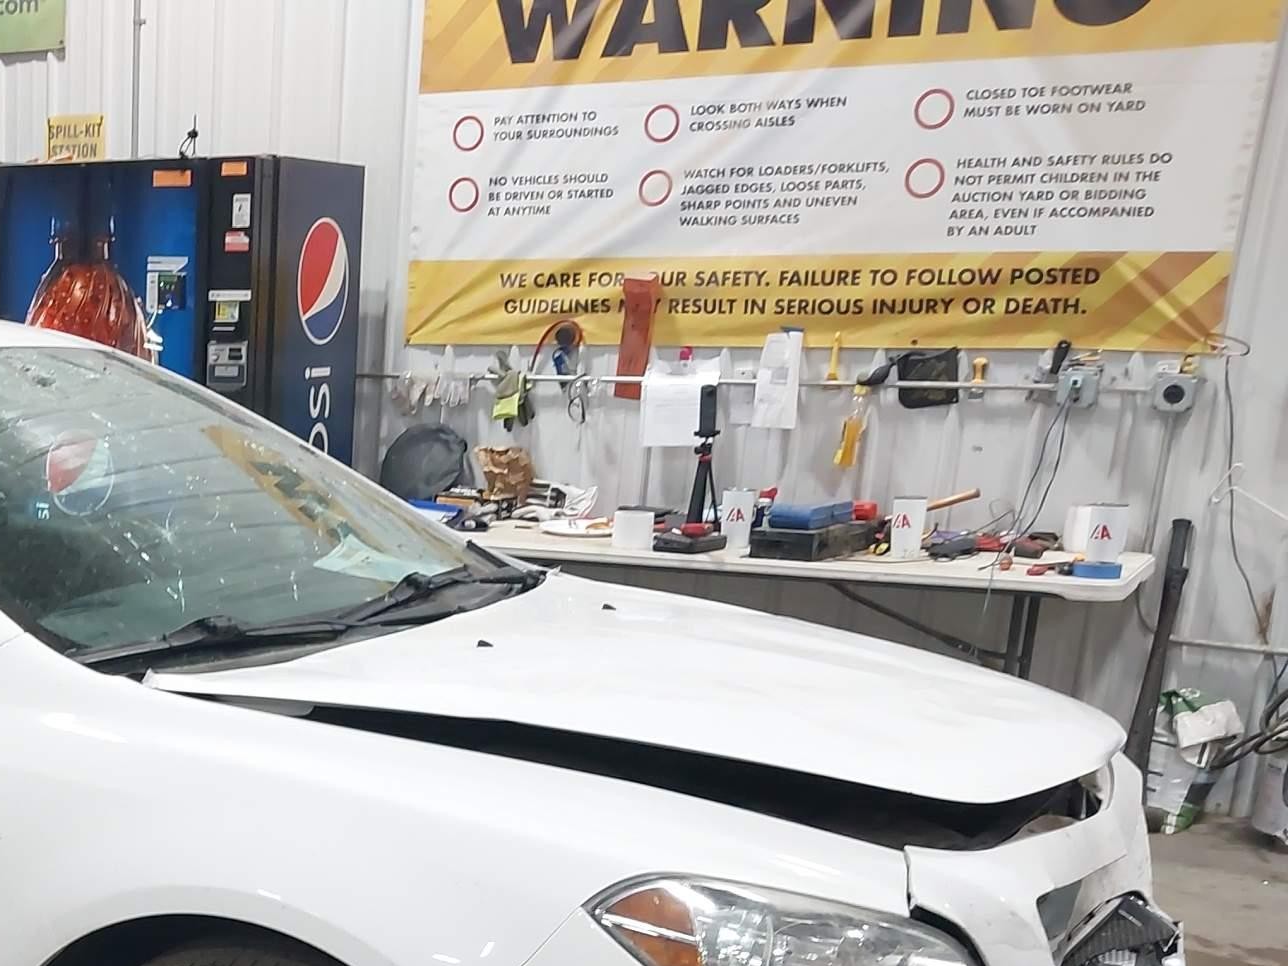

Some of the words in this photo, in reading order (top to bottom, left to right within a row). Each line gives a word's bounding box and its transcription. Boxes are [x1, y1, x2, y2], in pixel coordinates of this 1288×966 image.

[496, 0, 1152, 63] WARN
[966, 88, 1017, 101] CLOSED
[1021, 86, 1046, 98] TOE
[1050, 83, 1133, 97] FOOTWEAR
[690, 103, 725, 116] LOOK
[729, 101, 763, 114] BOTH
[765, 98, 802, 111] WAYS
[806, 96, 848, 109] WHEN
[963, 106, 1002, 118] MUST
[1005, 104, 1021, 116] BE
[1025, 103, 1072, 116] WORN
[1077, 102, 1101, 114] ON
[1106, 100, 1146, 112] YARD
[494, 116, 513, 126] PAY
[516, 113, 578, 125] ATTENTION
[582, 111, 597, 122] TO
[689, 118, 751, 132] CROSSING
[755, 115, 796, 127] AISLES
[49, 123, 101, 140] SPILL-KIT
[493, 131, 522, 142] YOUR
[527, 126, 619, 140] SURROUNDINGS
[957, 157, 1007, 169] HEALTH
[1011, 156, 1042, 167] AND
[1047, 154, 1097, 166] SAFETY
[1101, 153, 1145, 165] RULES
[1149, 152, 1173, 164] DO
[684, 167, 725, 180] WATCH
[729, 166, 754, 178] FOR
[759, 161, 890, 177] LOADERS/FORKLIFTS,
[954, 175, 983, 186] NOT
[987, 173, 1036, 185] PERMIT
[1040, 172, 1109, 184] CHILDREN
[1113, 171, 1130, 182] IN
[1135, 170, 1161, 181] THE
[488, 176, 508, 187] NO
[512, 175, 559, 186] VEHICLES
[563, 173, 609, 185] SHOULD
[681, 183, 730, 196] JAGGED
[734, 181, 776, 194] EDGES,
[780, 180, 820, 192] LOOSE
[824, 178, 867, 191] PARTS,
[488, 191, 501, 202] BE
[504, 190, 544, 201] DRIVEN
[547, 189, 563, 200] OR
[567, 188, 614, 199] STARTED
[951, 191, 1013, 203] AUCTION
[1018, 190, 1054, 201] YARD
[1058, 189, 1079, 201] OR
[1084, 188, 1146, 200] BIDDING
[487, 206, 502, 217] AT
[503, 205, 551, 216] ANYTIME
[680, 200, 721, 212] SHARP
[724, 198, 770, 210] POINTS
[772, 197, 801, 209] AND
[805, 196, 858, 208] UNEVEN
[679, 215, 737, 227] WALKING
[740, 213, 800, 226] SURFACES
[949, 208, 989, 221] AREA,
[993, 208, 1029, 219] EVEN
[1033, 207, 1045, 218] IF
[1048, 206, 1155, 218] ACCOMPANIED
[946, 225, 964, 237] BY
[967, 225, 989, 236] AN
[993, 224, 1038, 236] ADULT
[500, 273, 527, 289] WE
[533, 272, 581, 288] CARE
[588, 271, 625, 287] FOR
[693, 270, 770, 287] SAFETY.
[778, 269, 862, 287] FAILURE
[869, 269, 897, 286] TO
[905, 268, 1002, 286] FOLLOW
[1009, 267, 1101, 285] POSTED
[504, 298, 611, 315] GUIDELINES
[668, 299, 738, 315] RESULT
[743, 299, 766, 315] IN
[773, 298, 864, 315] SERIOUS
[871, 298, 955, 314] INJURY
[962, 297, 995, 314] OR
[1004, 297, 1088, 314] DEATH.
